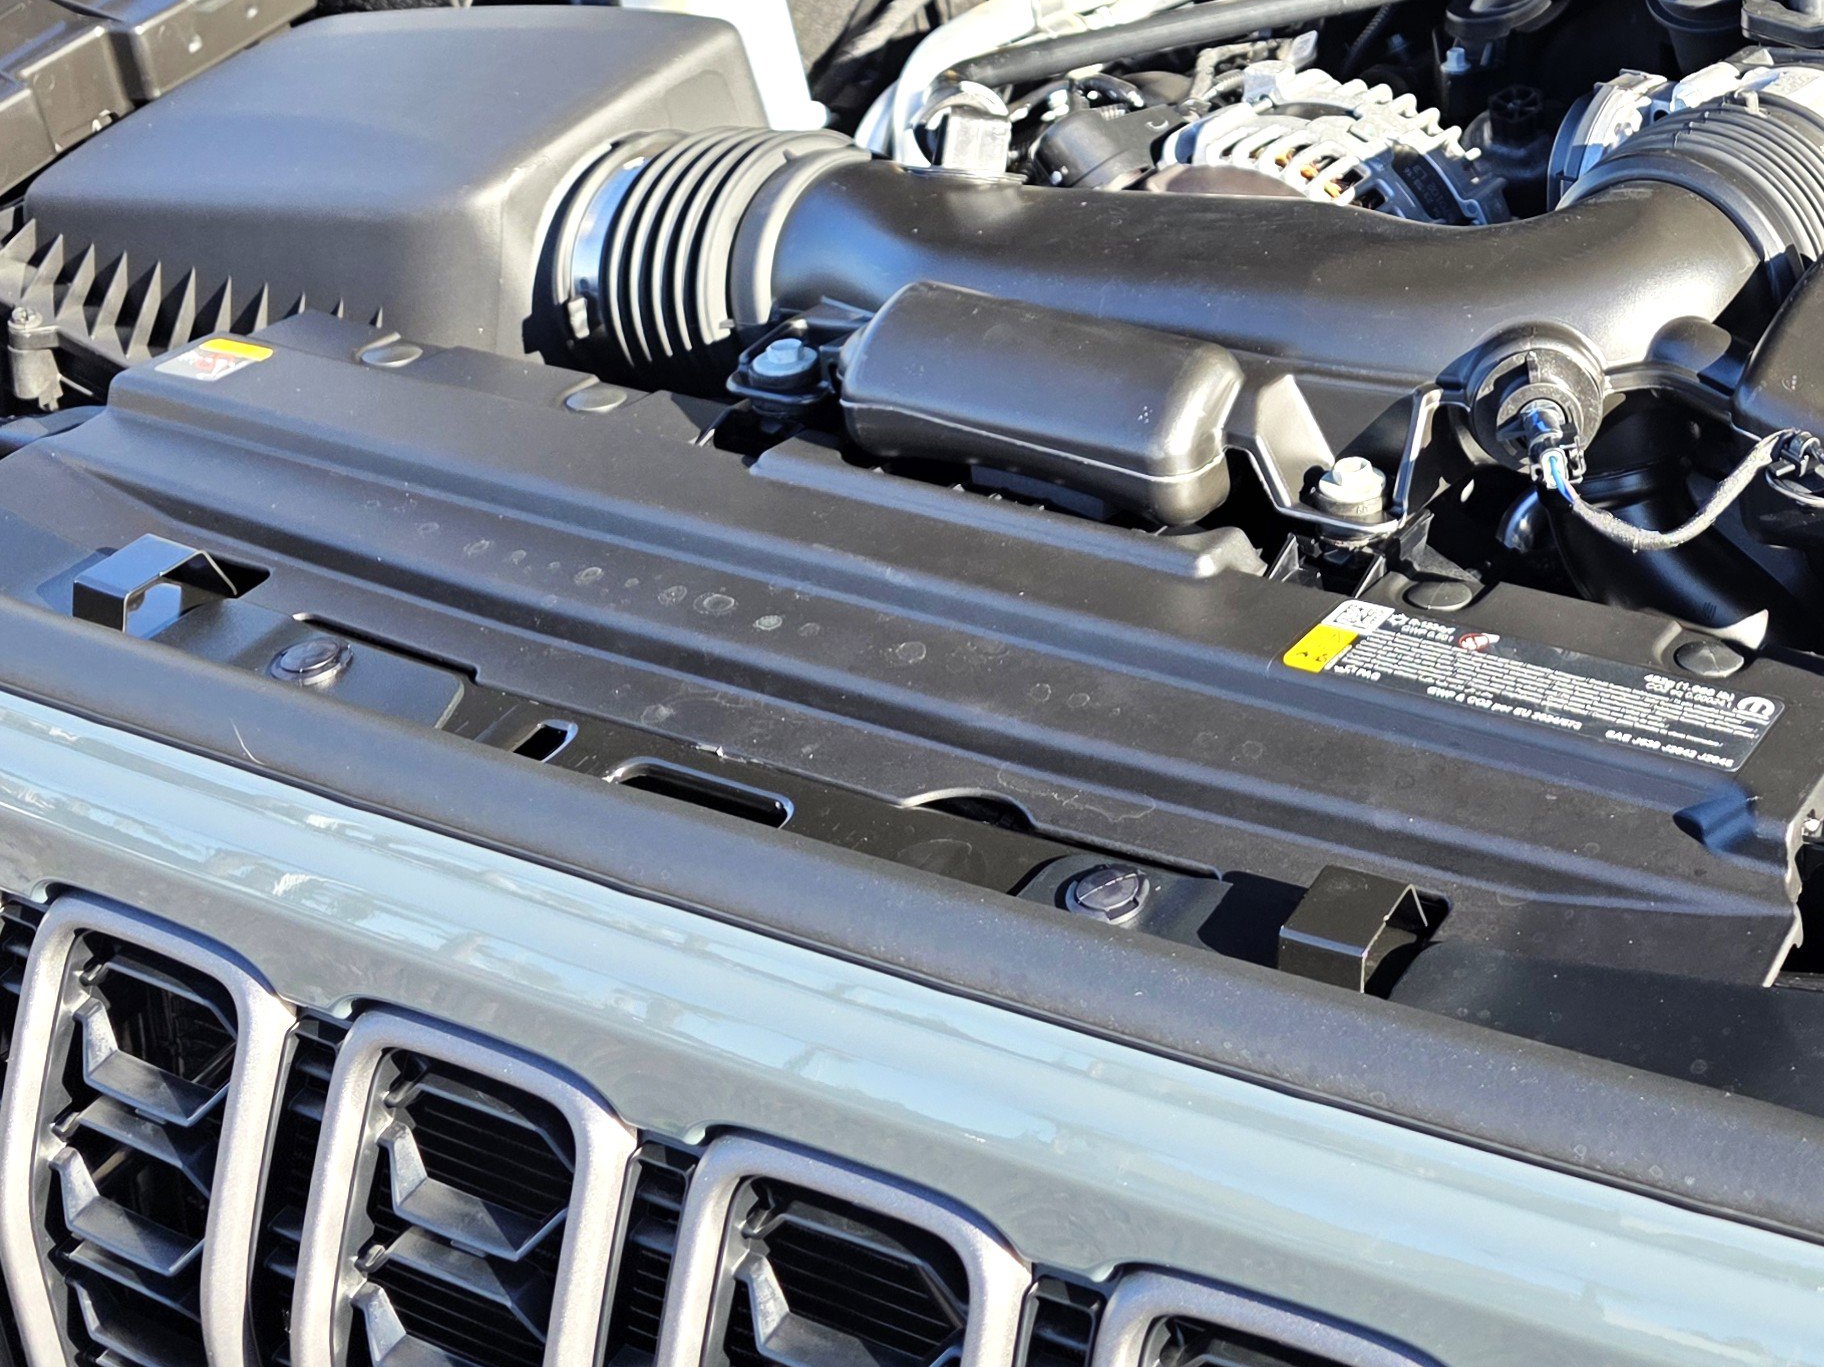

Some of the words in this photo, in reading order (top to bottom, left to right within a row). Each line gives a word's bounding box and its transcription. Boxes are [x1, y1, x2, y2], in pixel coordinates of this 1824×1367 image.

[1426, 685, 1457, 699] GWP
[1466, 695, 1493, 709] CO2
[1491, 702, 1514, 714] per
[1513, 707, 1532, 718] EU
[1605, 729, 1632, 744] SAE
